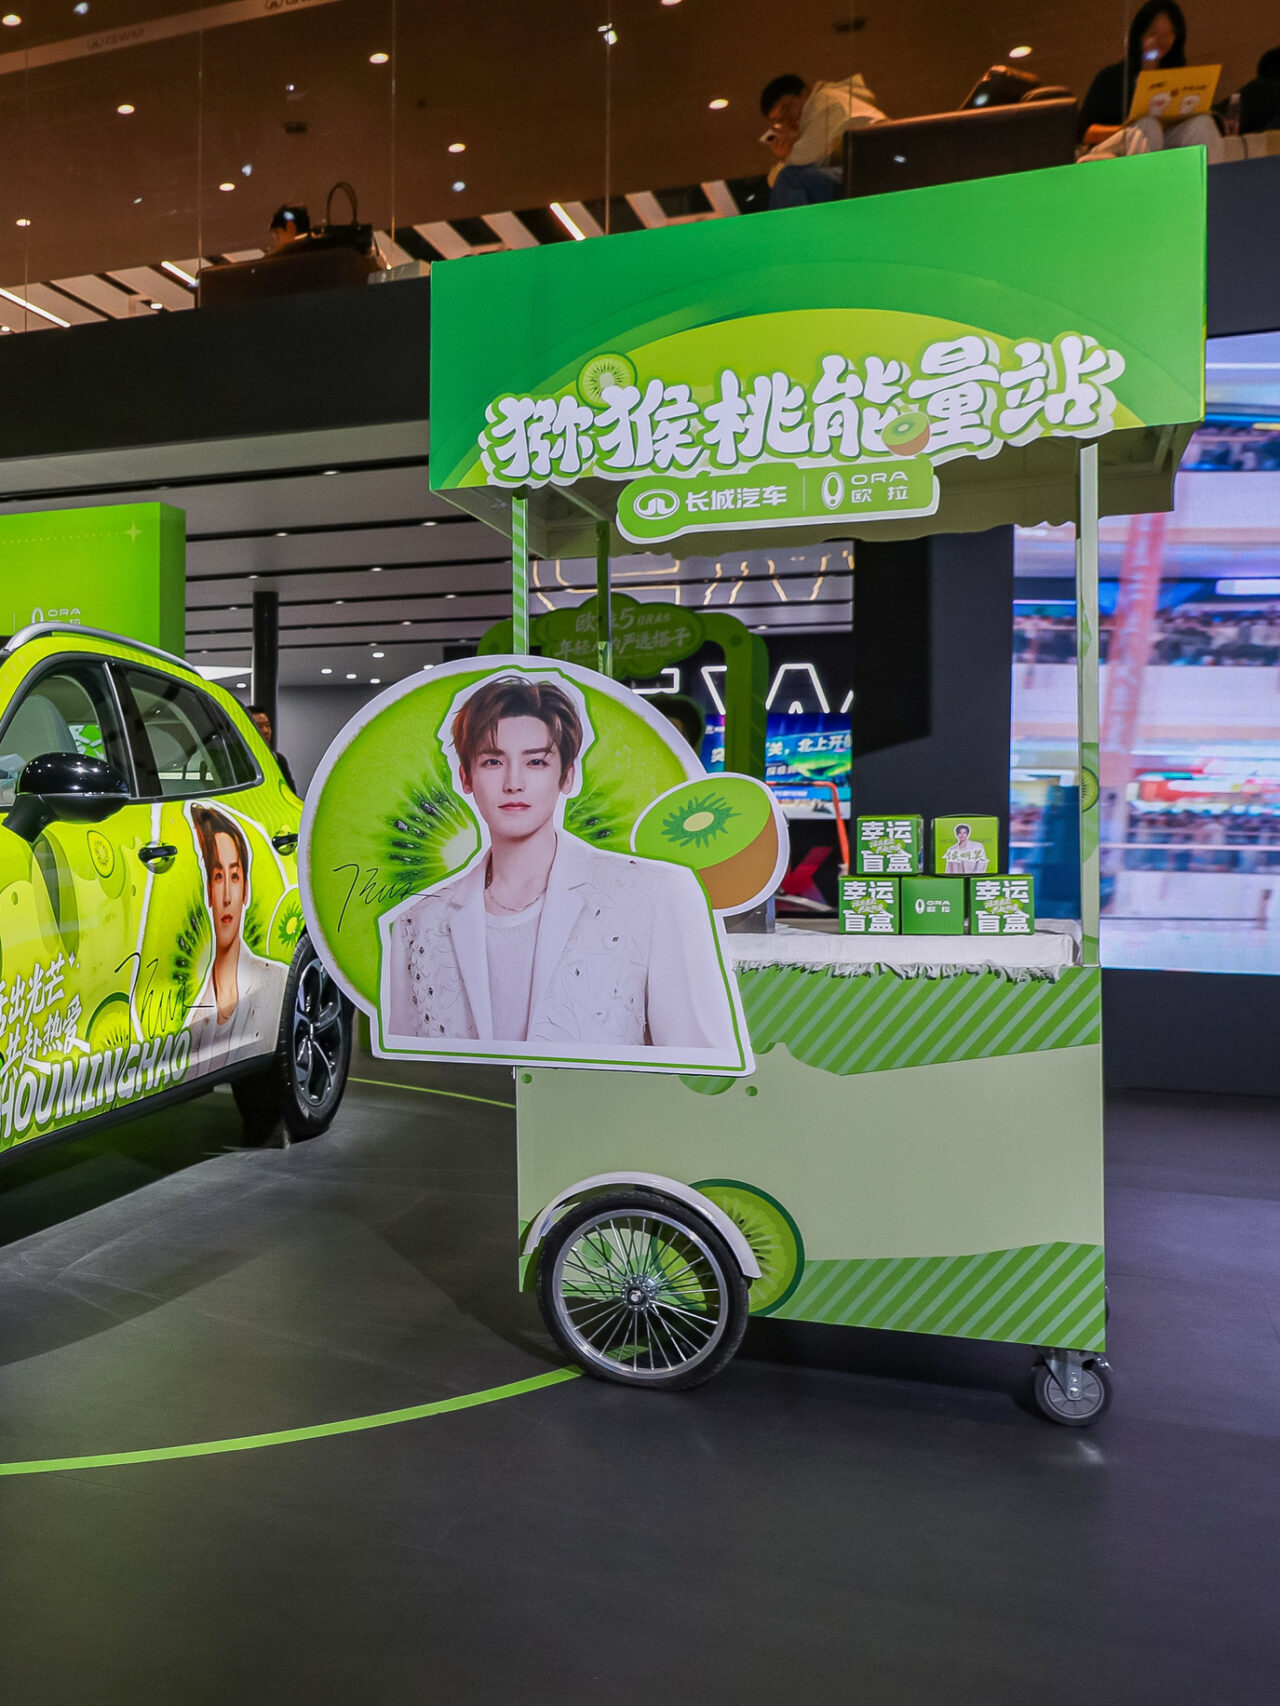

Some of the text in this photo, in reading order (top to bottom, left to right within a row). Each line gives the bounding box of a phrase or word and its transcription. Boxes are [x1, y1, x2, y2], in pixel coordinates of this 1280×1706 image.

[488, 335, 1110, 477] 猕猴桃能量站
[850, 471, 909, 486] ORA
[685, 485, 788, 512] 长城汽车
[851, 486, 909, 504] 欧拉
[47, 608, 82, 618] ORA
[861, 821, 912, 843] 幸运
[861, 849, 912, 872] 盲盒
[843, 881, 894, 904] 幸运
[975, 880, 1030, 904] 幸运
[843, 909, 894, 932] 盲盒
[975, 909, 1030, 933] 盲盒
[0, 993, 91, 1078] 共赴热爱
